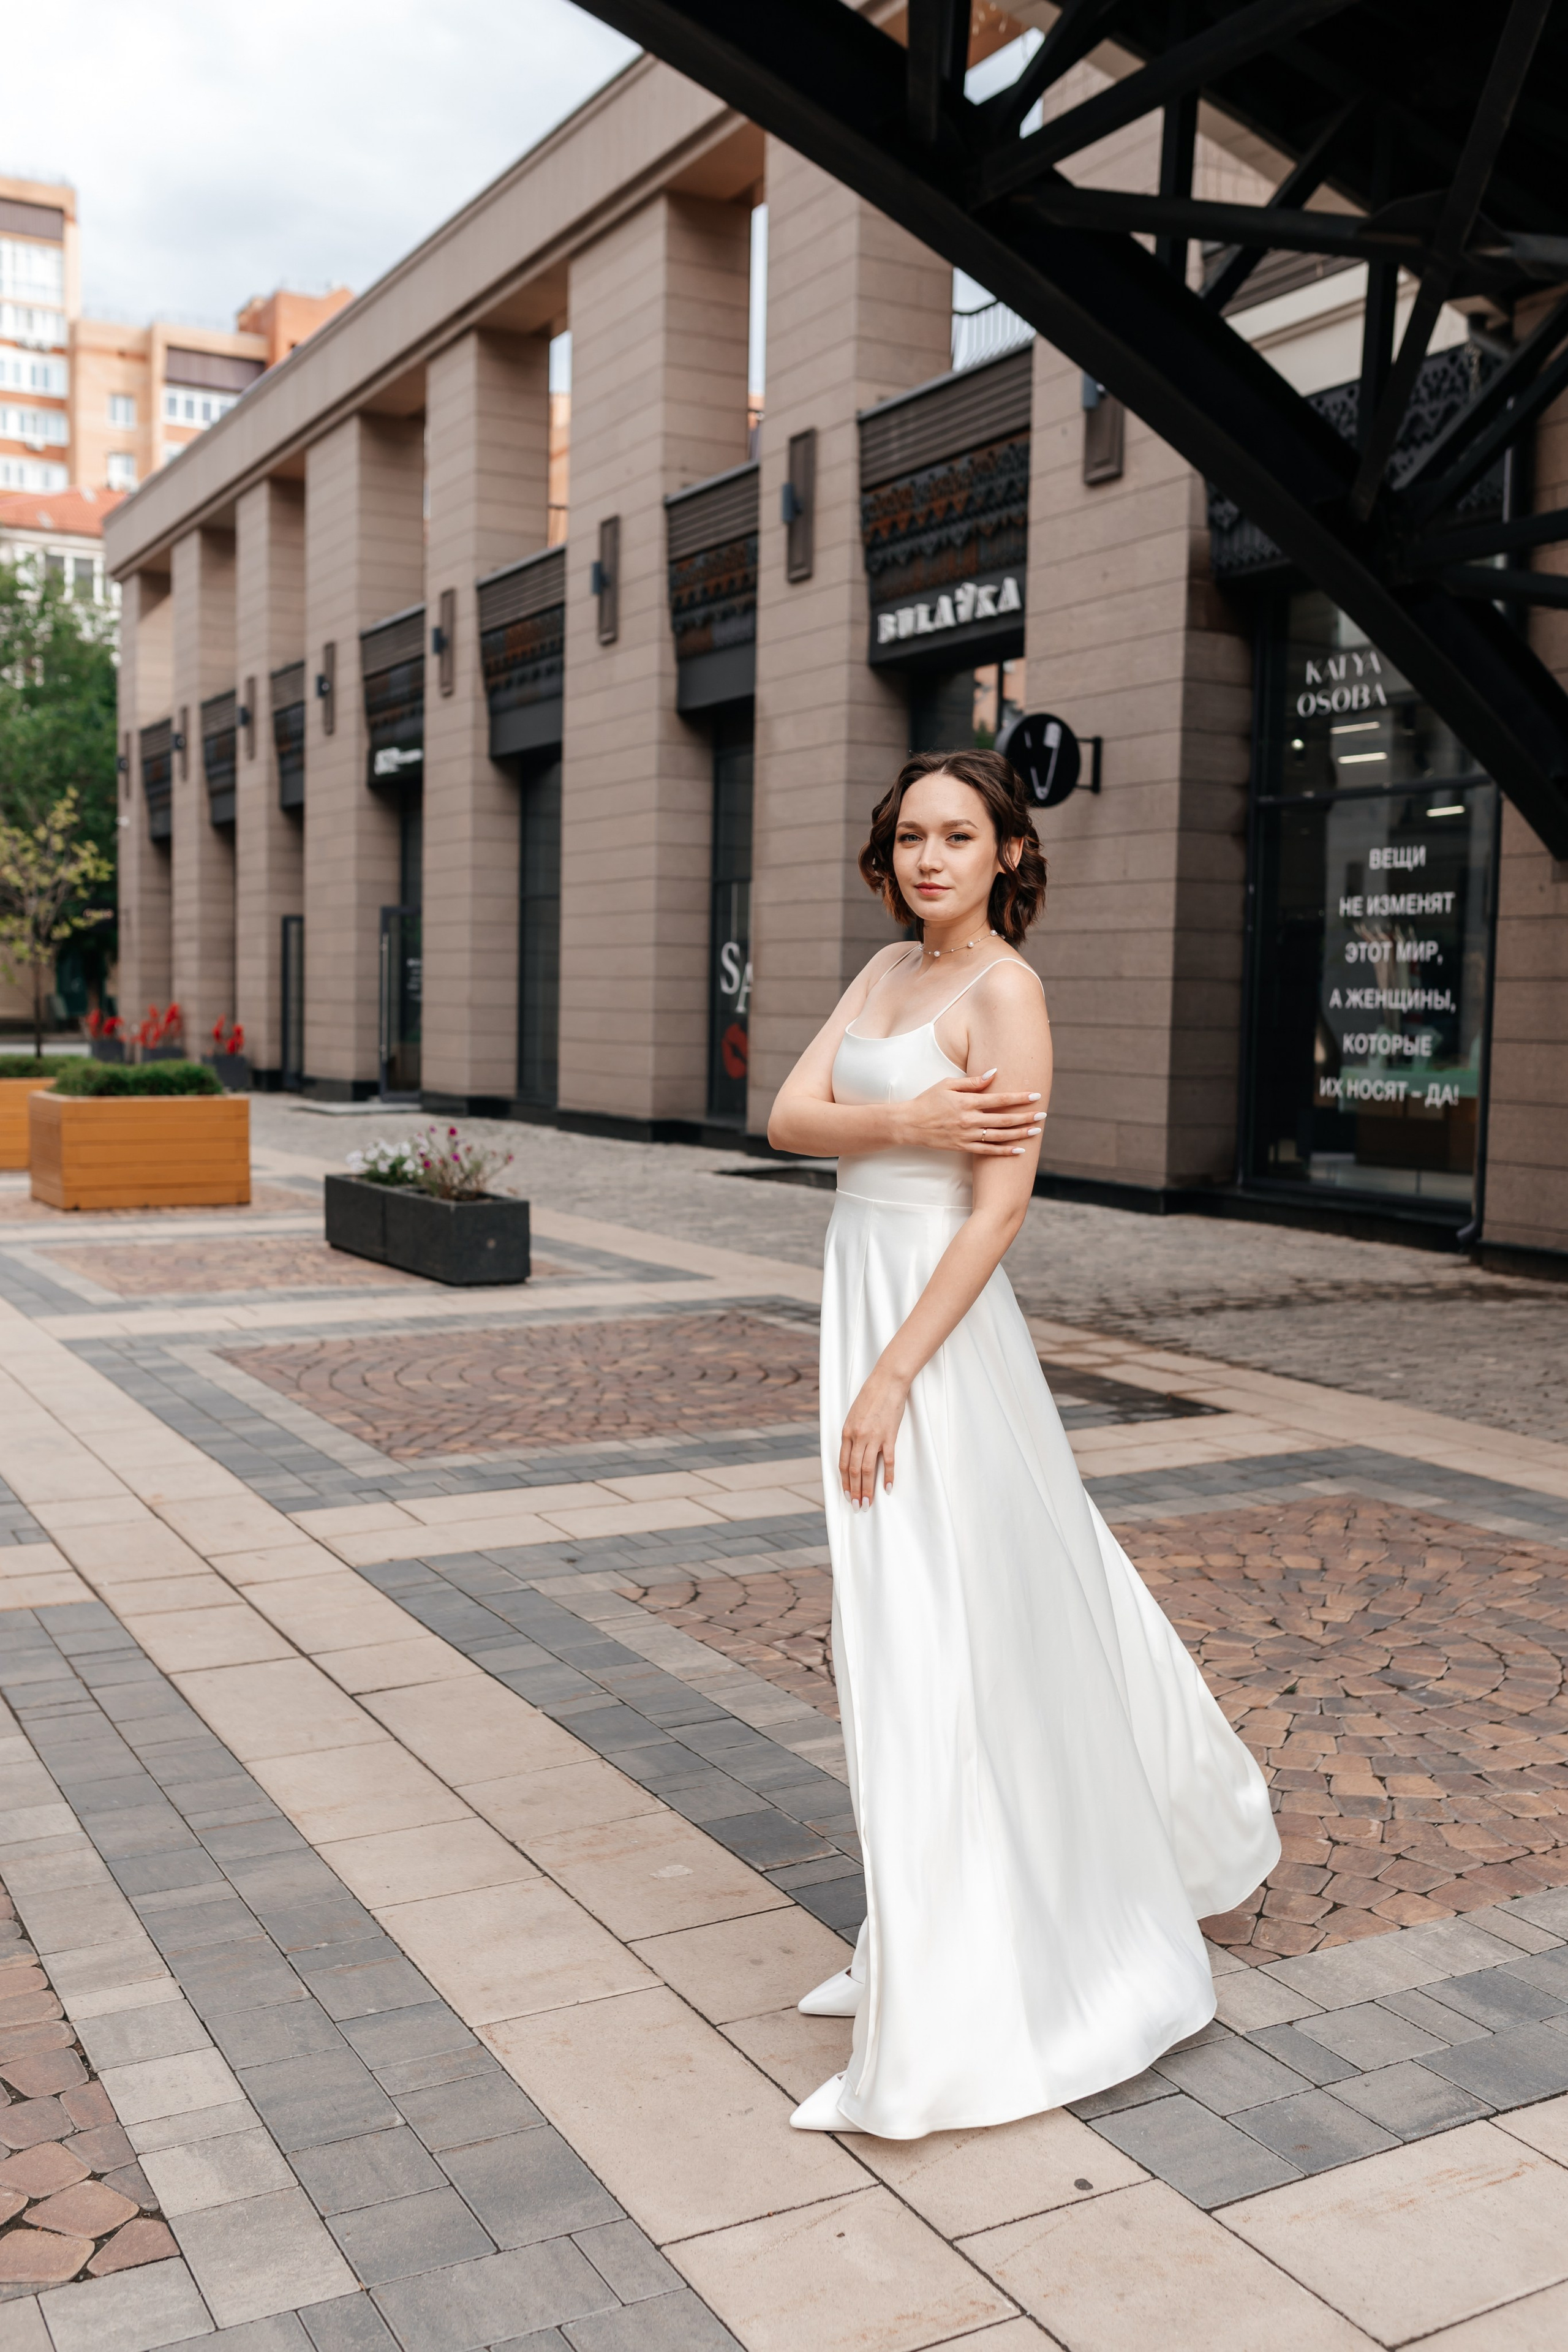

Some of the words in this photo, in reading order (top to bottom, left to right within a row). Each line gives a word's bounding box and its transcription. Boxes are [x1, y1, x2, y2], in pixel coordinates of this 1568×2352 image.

[1305, 650, 1382, 685] KATYA
[1297, 682, 1387, 718] OSOBA
[1369, 845, 1427, 872] ВЕЩИ
[1340, 895, 1363, 918] НЕ
[1366, 891, 1455, 916] ИЗМЕНЯТ
[1344, 941, 1393, 963] ЭТОТ
[1396, 940, 1444, 966] МИР,
[1329, 988, 1343, 1009] А
[1345, 988, 1456, 1014] ЖЕНЩИНЫ,
[1343, 1033, 1433, 1057] КОТОРЫЕ
[1319, 1077, 1343, 1098] ИХ
[1347, 1079, 1408, 1101] НОСЯТ
[1425, 1083, 1460, 1107] ДА!
